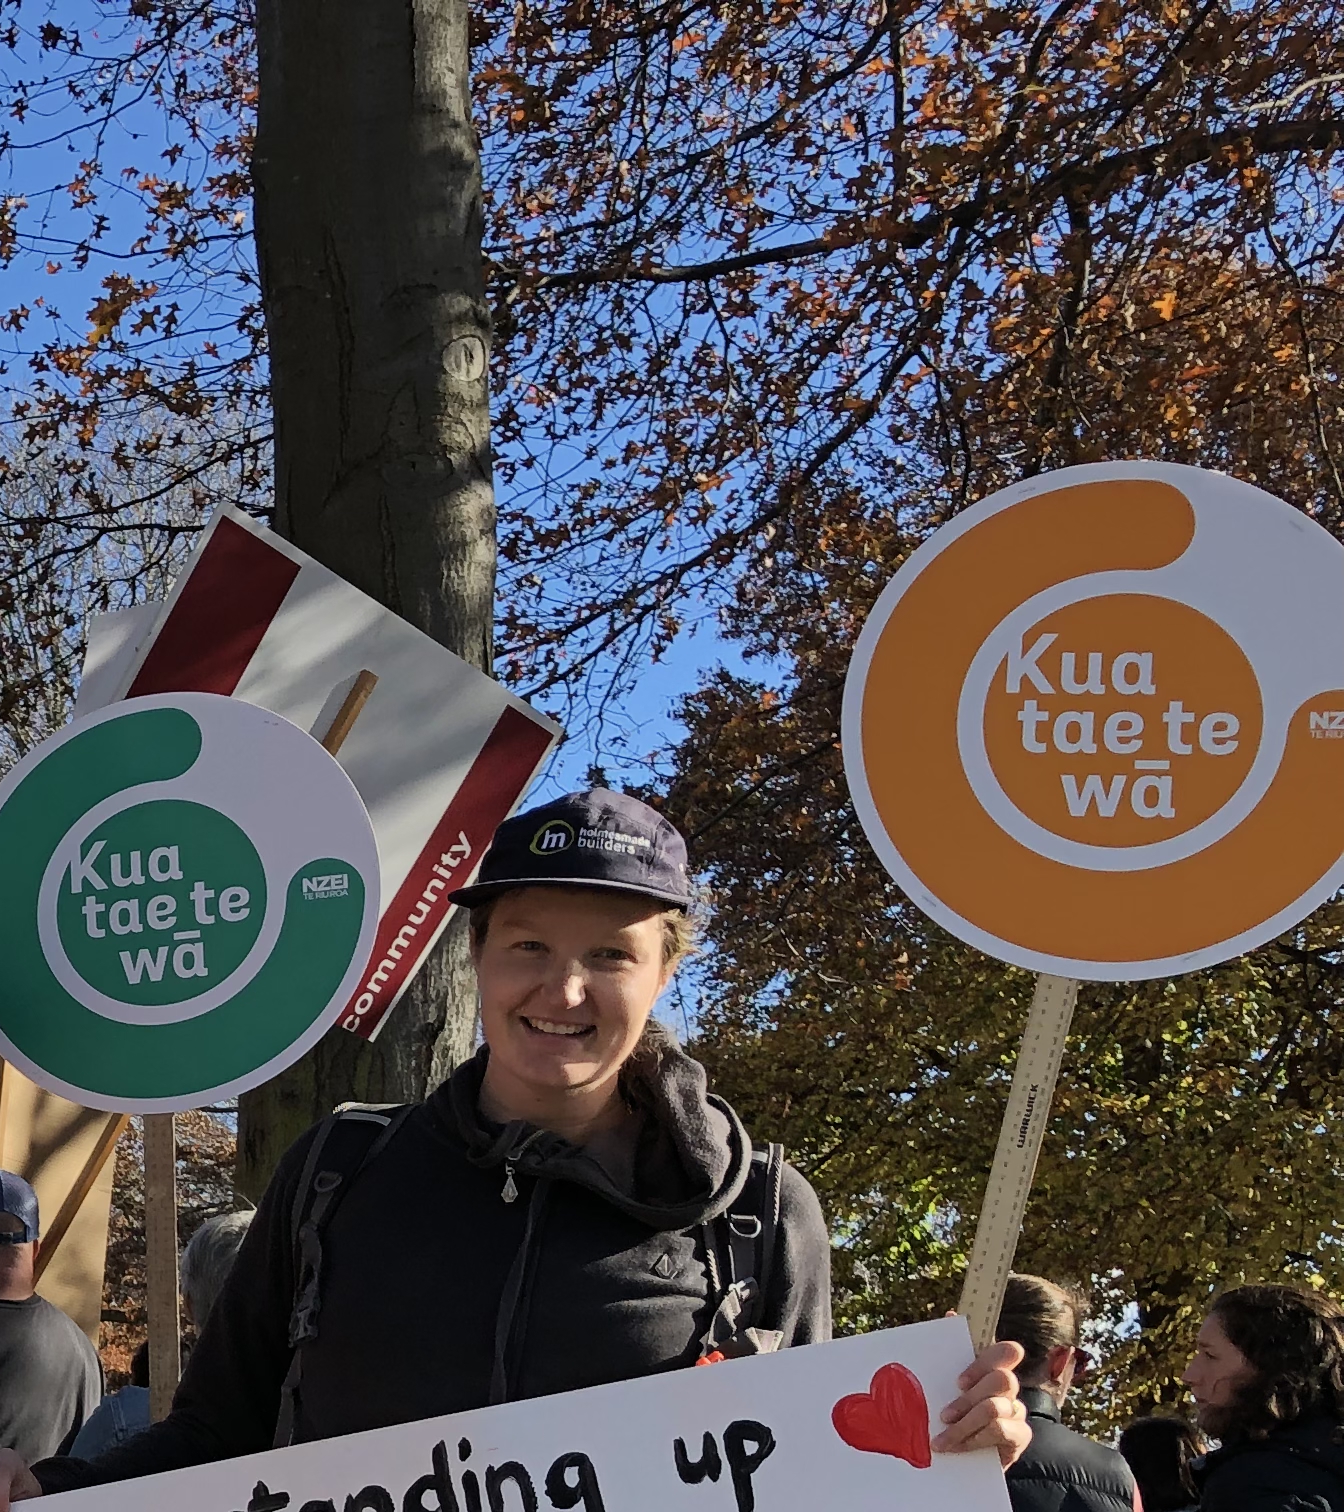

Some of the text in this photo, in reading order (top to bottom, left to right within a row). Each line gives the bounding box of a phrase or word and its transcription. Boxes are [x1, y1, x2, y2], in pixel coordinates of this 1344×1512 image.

[1006, 632, 1156, 695] Kua
[1018, 700, 1240, 755] tae te
[1060, 760, 1176, 818] wā
[68, 840, 183, 894] Kua
[577, 837, 636, 855] builders
[81, 882, 250, 938] tae te
[302, 873, 348, 892] NZEI
[120, 929, 209, 984] wā
[342, 830, 473, 1033] community
[1016, 1082, 1039, 1149] WARWICK
